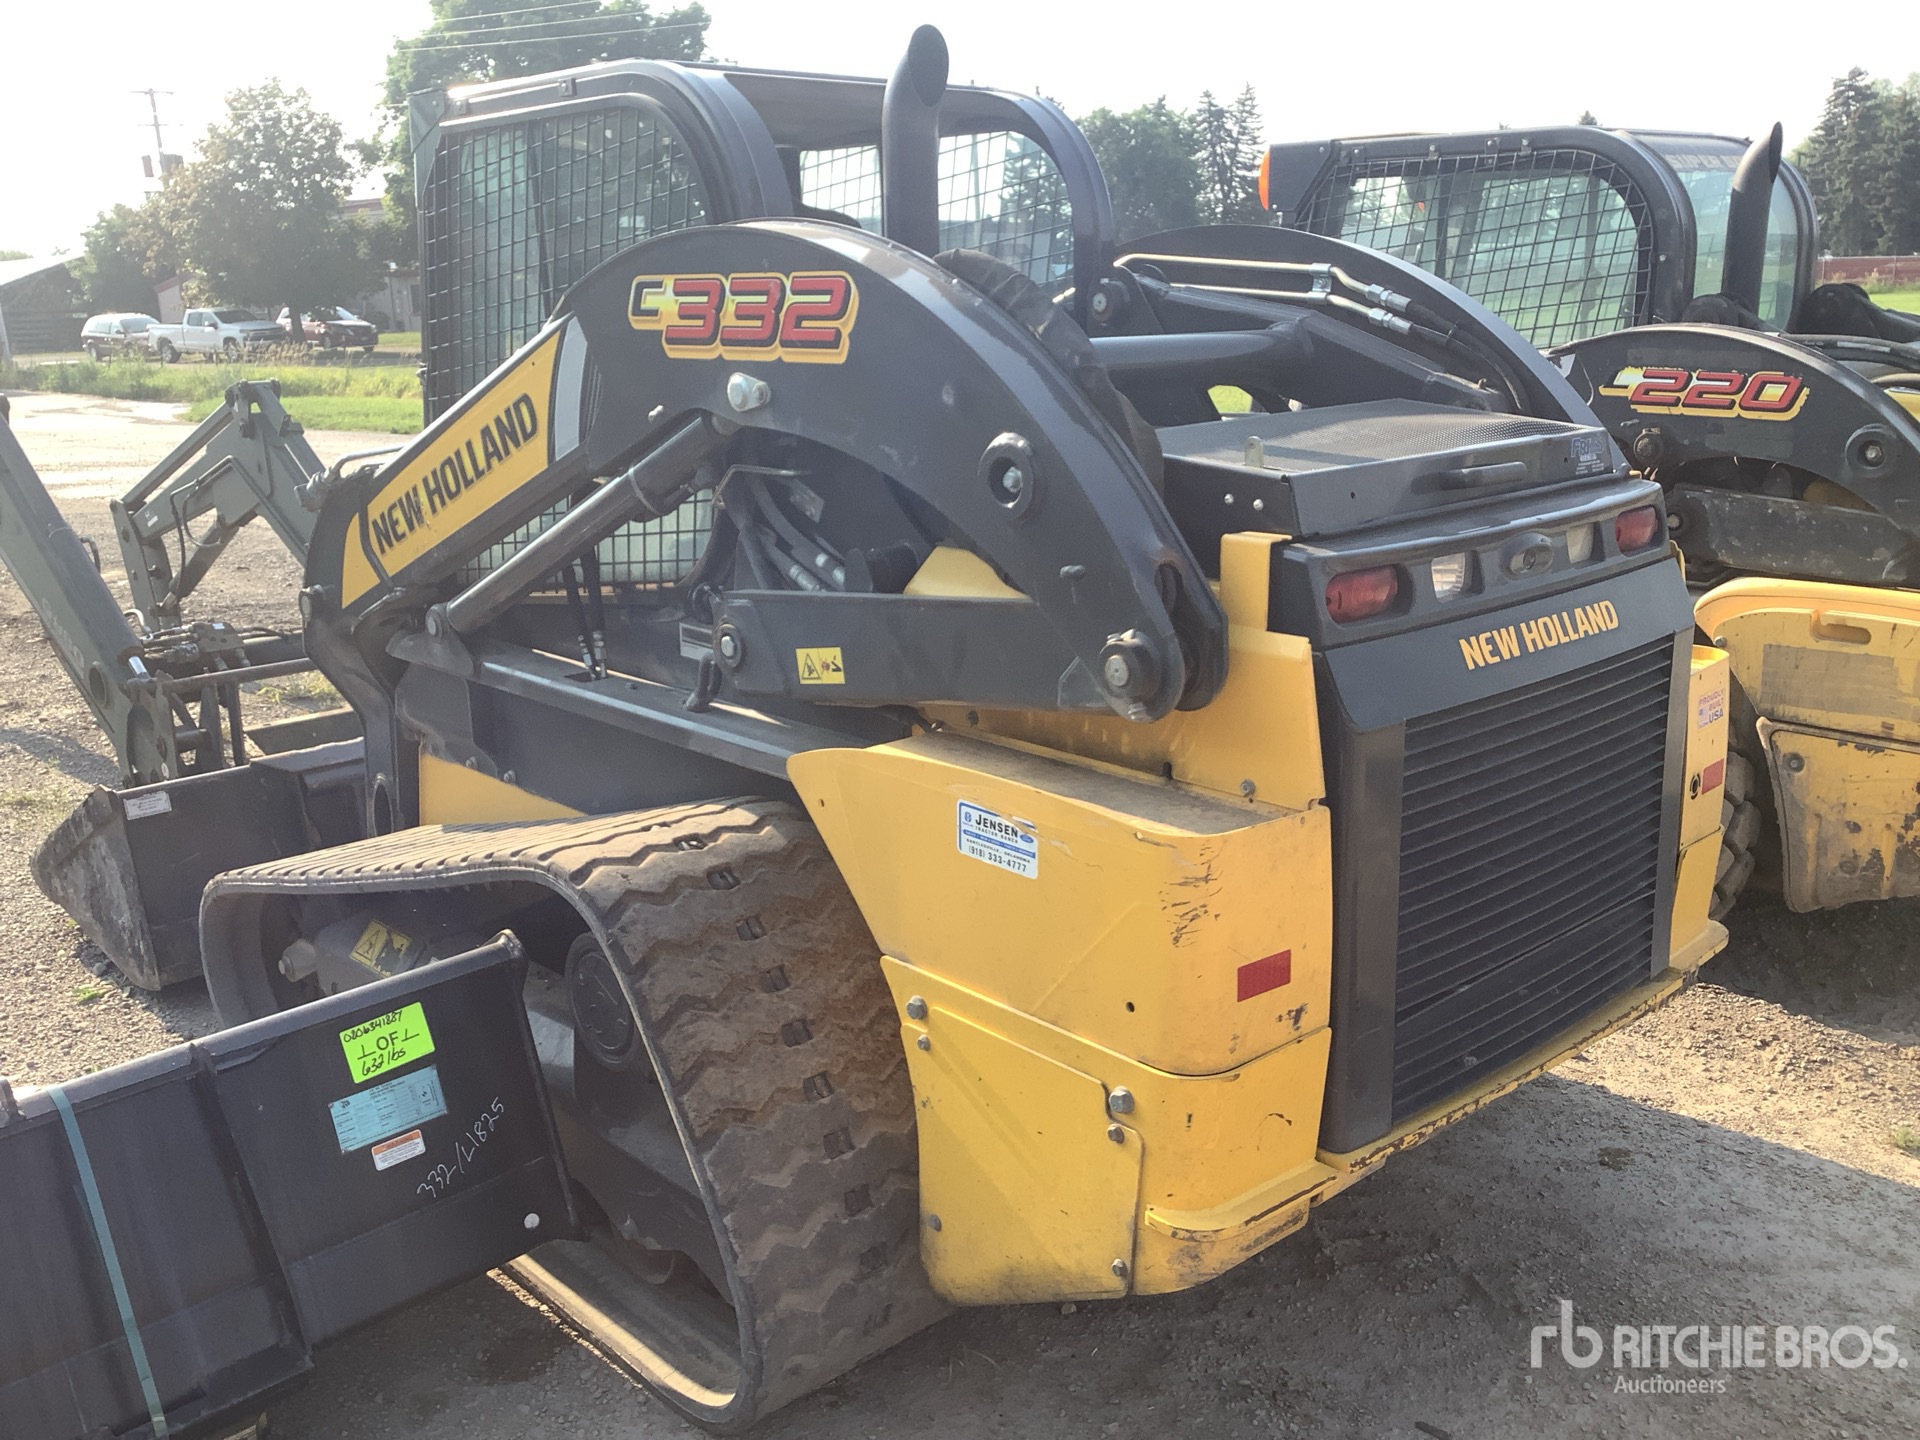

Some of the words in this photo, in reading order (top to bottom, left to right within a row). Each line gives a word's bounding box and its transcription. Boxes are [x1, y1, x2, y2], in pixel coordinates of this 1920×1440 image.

[371, 484, 424, 555] NEW
[422, 393, 538, 516] HOLLAND
[1458, 625, 1521, 671] NEW
[1519, 600, 1619, 653] HOLLAND
[1709, 708, 1724, 723] USA
[975, 814, 1018, 838] JENSEN
[975, 826, 998, 837] TRACTOR
[1000, 834, 1018, 844] RANCH
[969, 845, 986, 858] (918)
[987, 852, 1027, 872] 333-4777
[376, 1031, 399, 1051] OF
